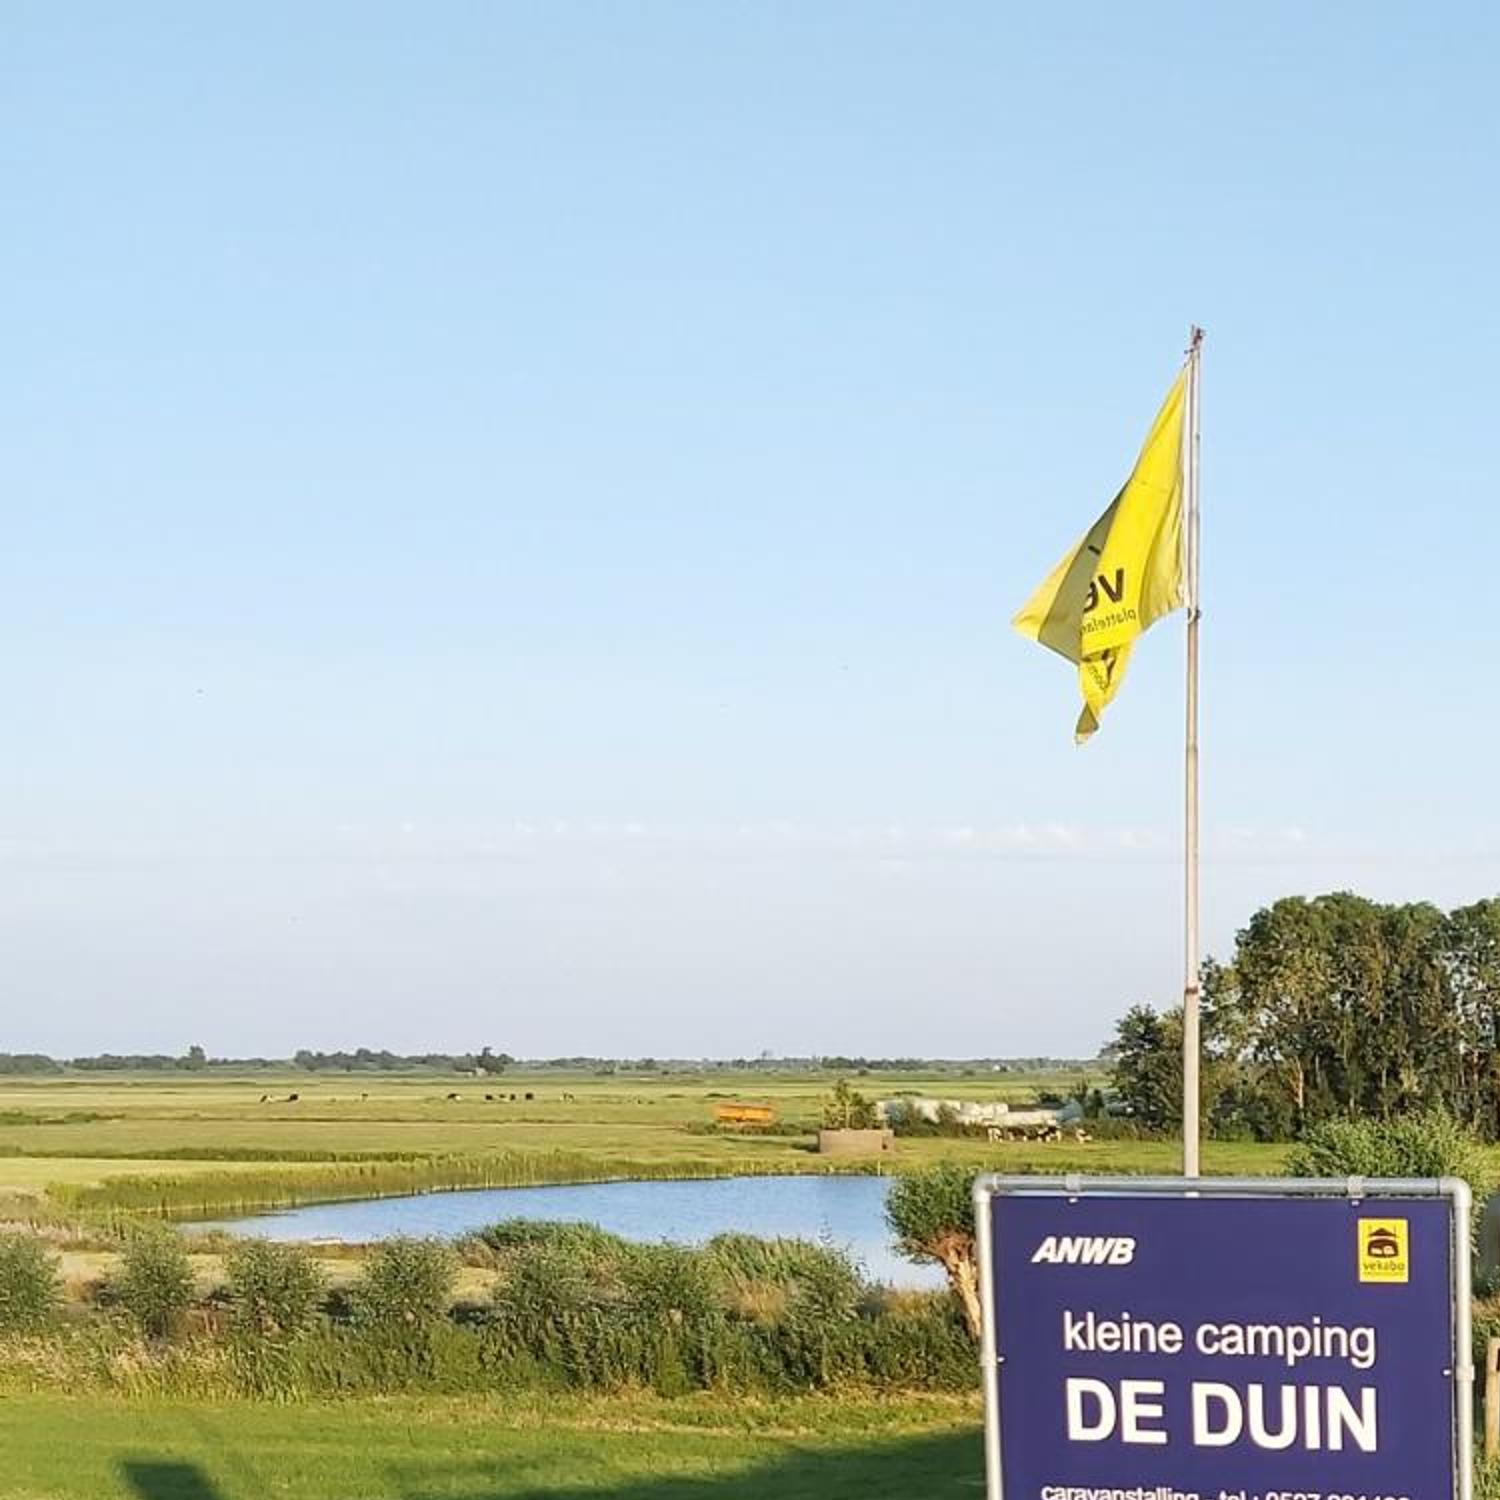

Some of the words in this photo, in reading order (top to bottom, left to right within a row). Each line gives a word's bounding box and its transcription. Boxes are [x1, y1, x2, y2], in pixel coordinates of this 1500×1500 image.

[1031, 1236, 1136, 1265] ANWB
[1063, 1310, 1183, 1354] kleine
[1195, 1316, 1376, 1369] camping
[1066, 1377, 1168, 1444] DE
[1191, 1381, 1377, 1452] DUIN
